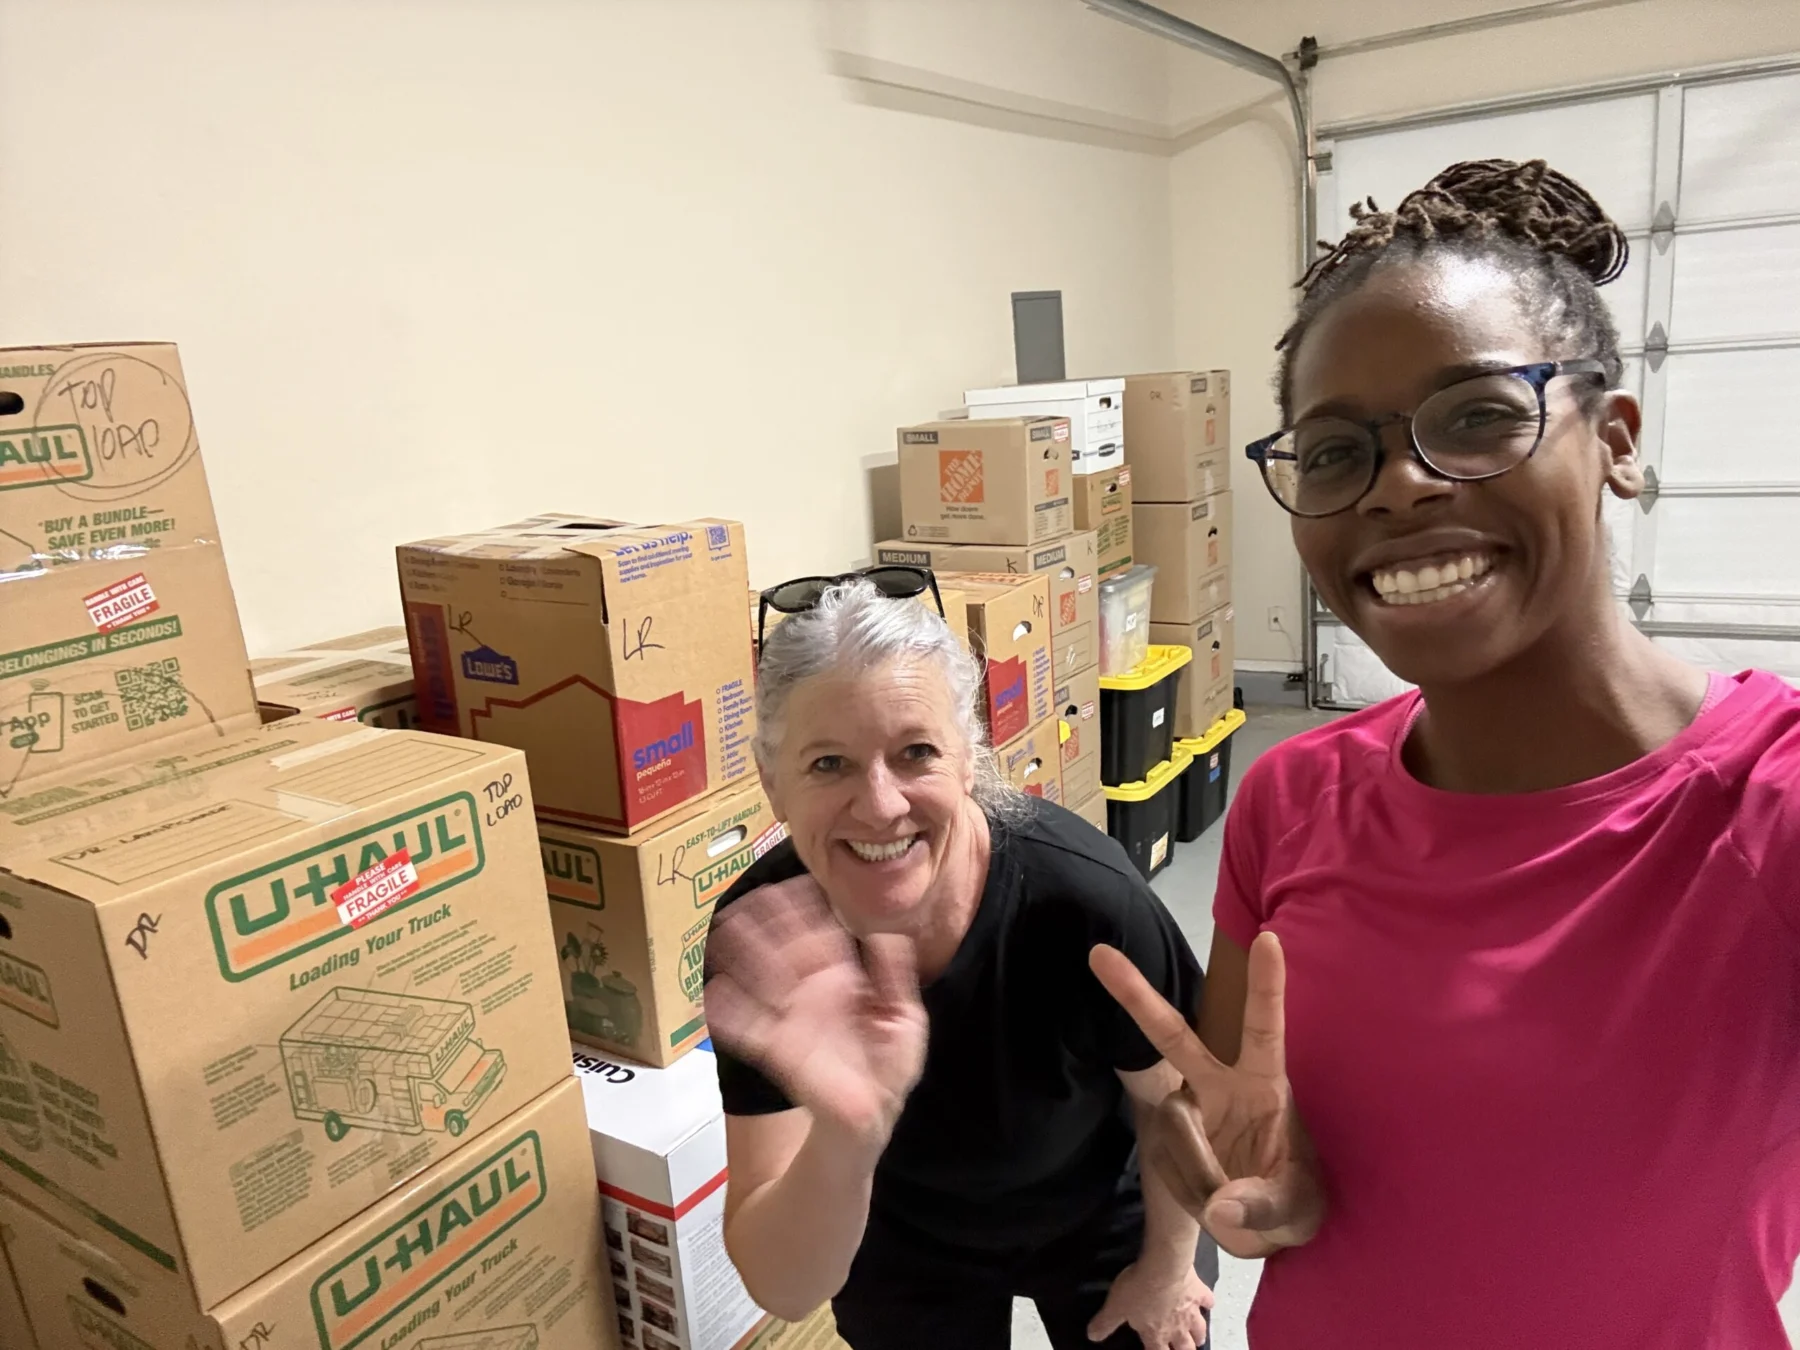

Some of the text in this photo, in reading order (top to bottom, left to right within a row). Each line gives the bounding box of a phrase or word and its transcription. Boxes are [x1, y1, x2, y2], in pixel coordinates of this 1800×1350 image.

[58, 368, 116, 424] TOP
[905, 433, 936, 443] SMALL
[940, 451, 983, 502] HOME
[48, 518, 176, 550] SAVE EVEN MORE!
[78, 514, 89, 528] A
[882, 552, 928, 564] MEDIUM
[92, 587, 152, 623] FRAGILE
[91, 636, 107, 651] IN
[109, 621, 179, 649] SECONDS!
[622, 616, 666, 661] LR
[74, 689, 103, 706] SCAN
[721, 679, 743, 693] FRAGILE
[10, 712, 51, 733] App
[71, 712, 120, 734] STARTED
[73, 701, 111, 719] TO GET
[723, 711, 740, 723] Dining
[724, 719, 744, 733] Kitchen
[633, 720, 694, 770] small
[636, 758, 672, 782] pequeña
[483, 773, 513, 803] TOP
[732, 801, 763, 826] HANDLES
[229, 814, 467, 936] U-HAUL
[355, 862, 386, 886] PLEASE
[657, 845, 695, 887] LR
[346, 869, 410, 918] FRAGILE
[366, 894, 402, 921] THANK YOU
[289, 947, 360, 991] Loading
[365, 925, 404, 955] Your
[407, 903, 452, 935] Truck
[331, 1157, 531, 1317] U-HAUL
[380, 1300, 441, 1350] Loading
[444, 1269, 478, 1302] Your
[480, 1236, 519, 1275] Truck
